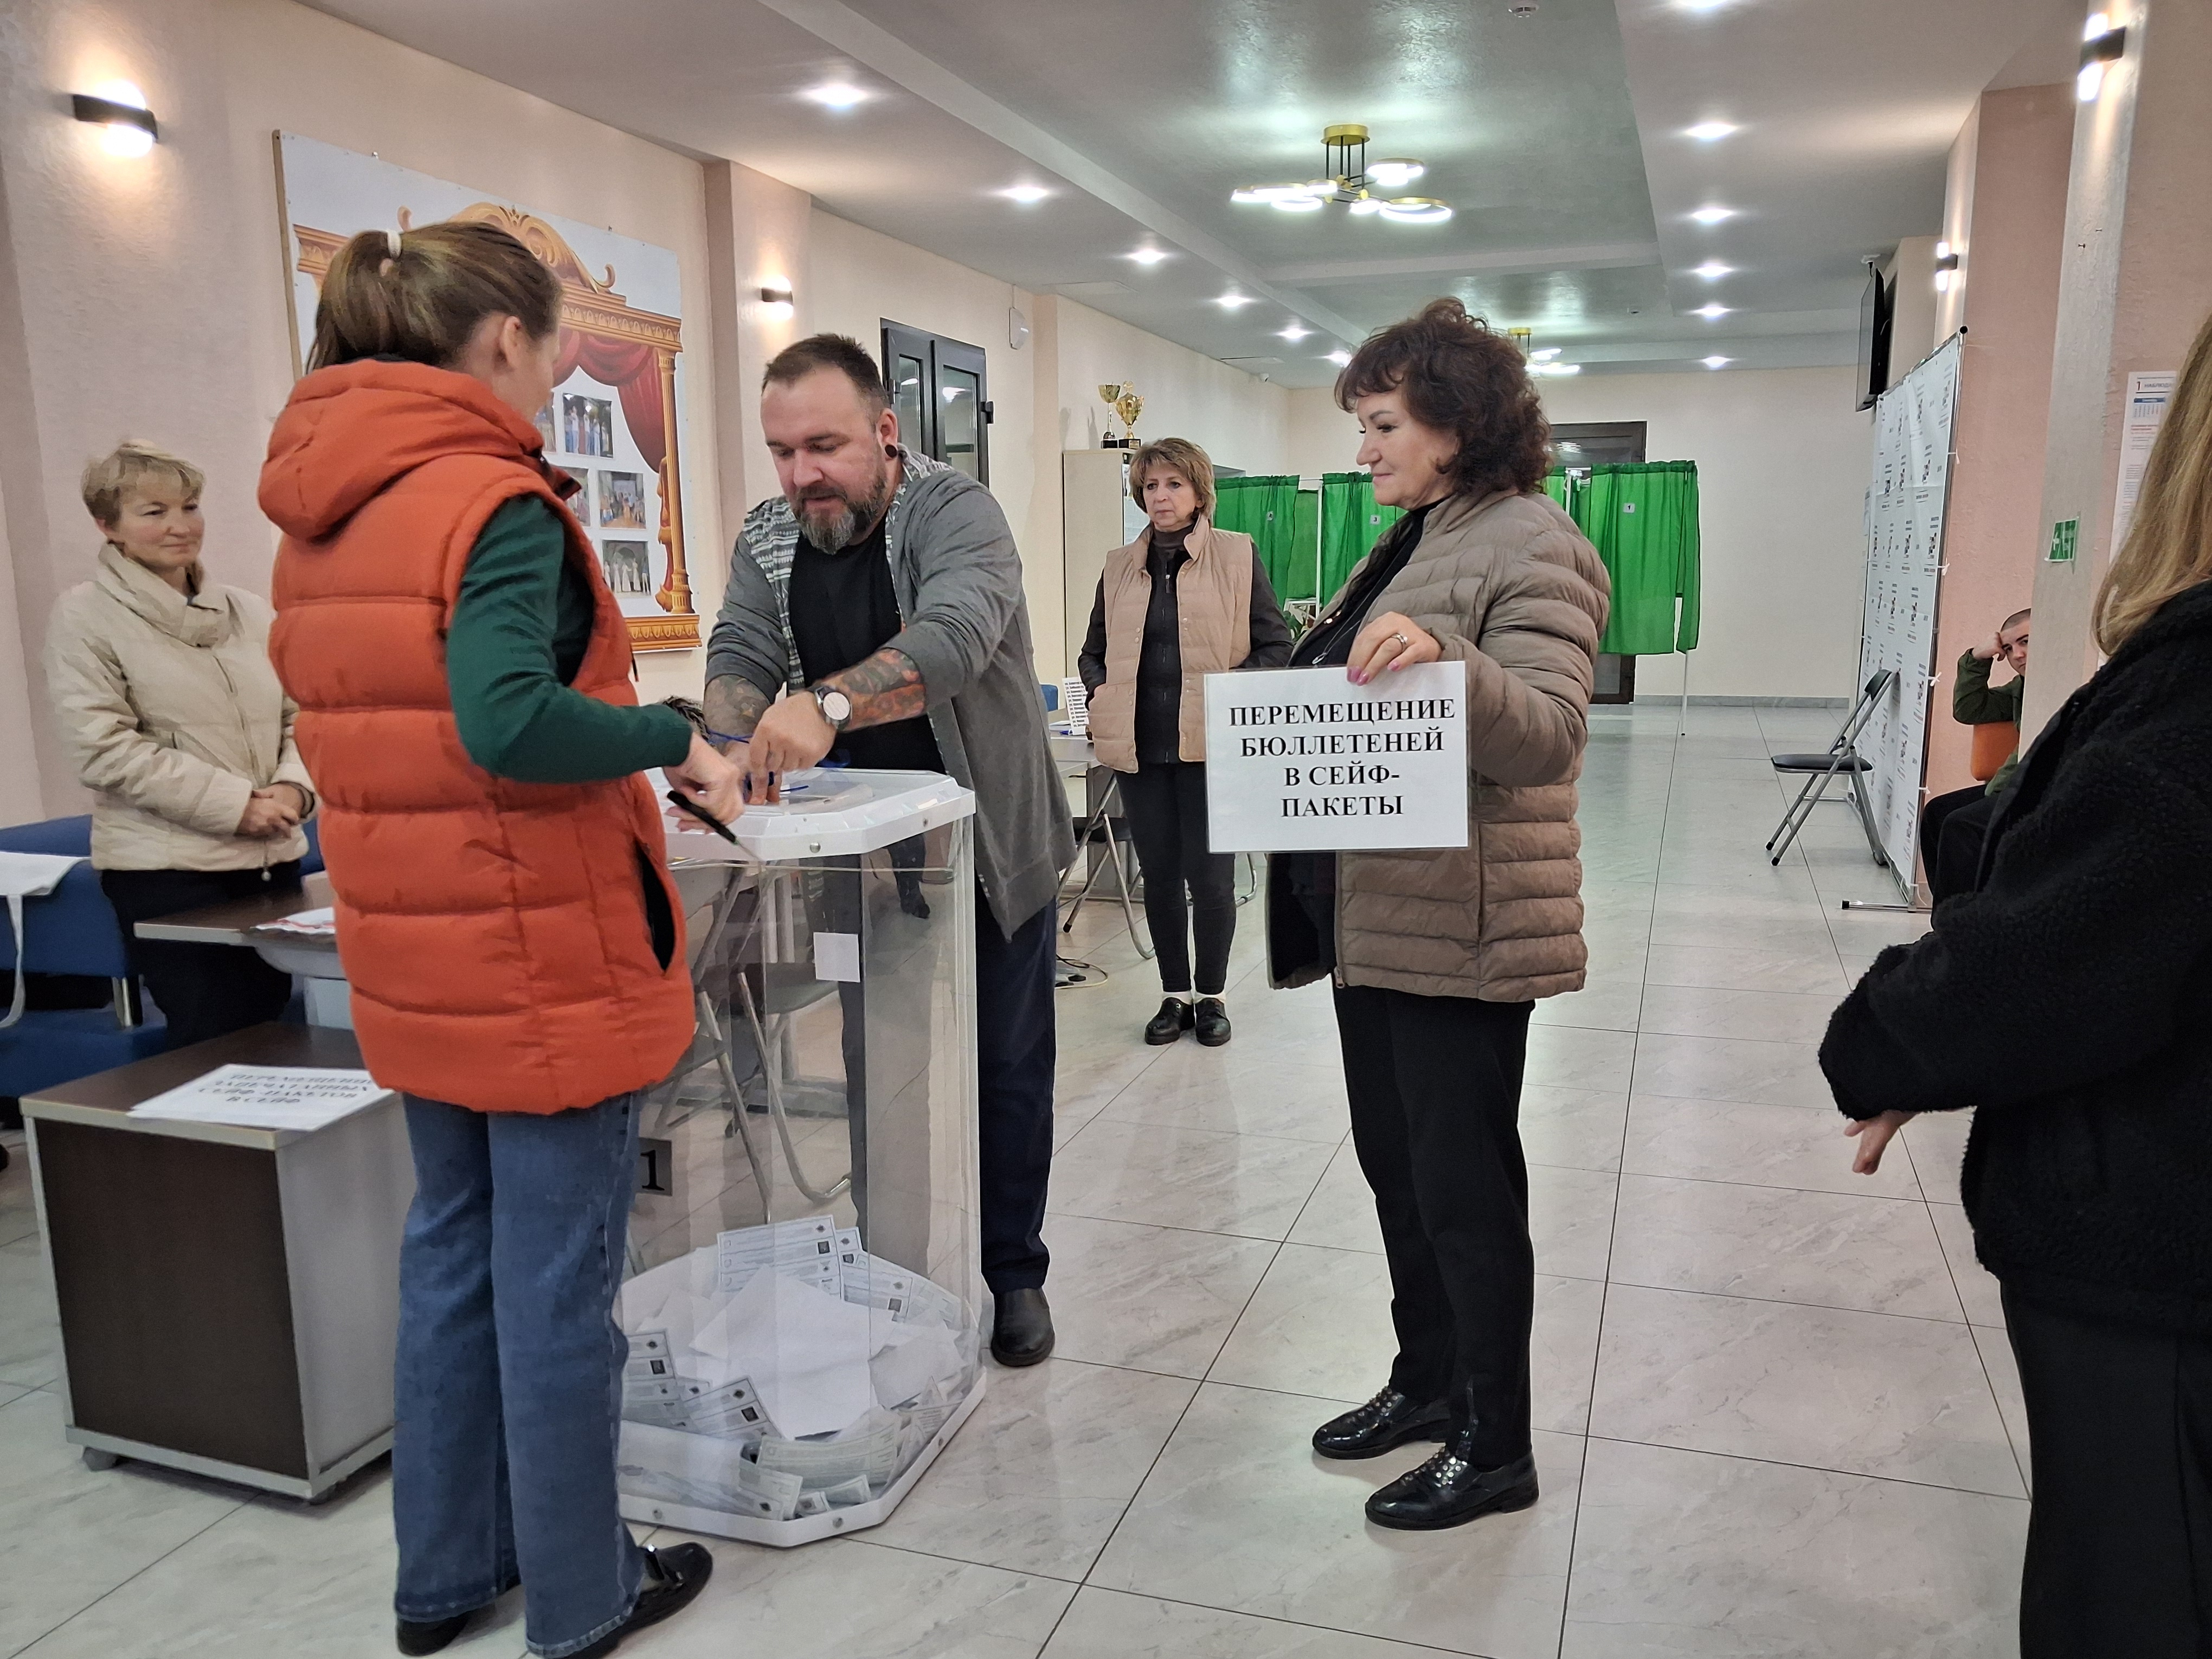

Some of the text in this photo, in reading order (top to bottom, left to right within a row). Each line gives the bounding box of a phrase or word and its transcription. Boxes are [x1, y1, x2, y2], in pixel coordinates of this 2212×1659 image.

[2137, 381, 2141, 391] 1
[1229, 699, 1455, 726] ПЕРЕМЕЩЕНИЕ
[1240, 726, 1444, 757] БЮЛЛЕТЕНЕЙ
[1284, 760, 1400, 787] В СЕЙФ-
[1281, 795, 1404, 817] ПАКЕТЫ
[640, 1149, 665, 1191] 1
